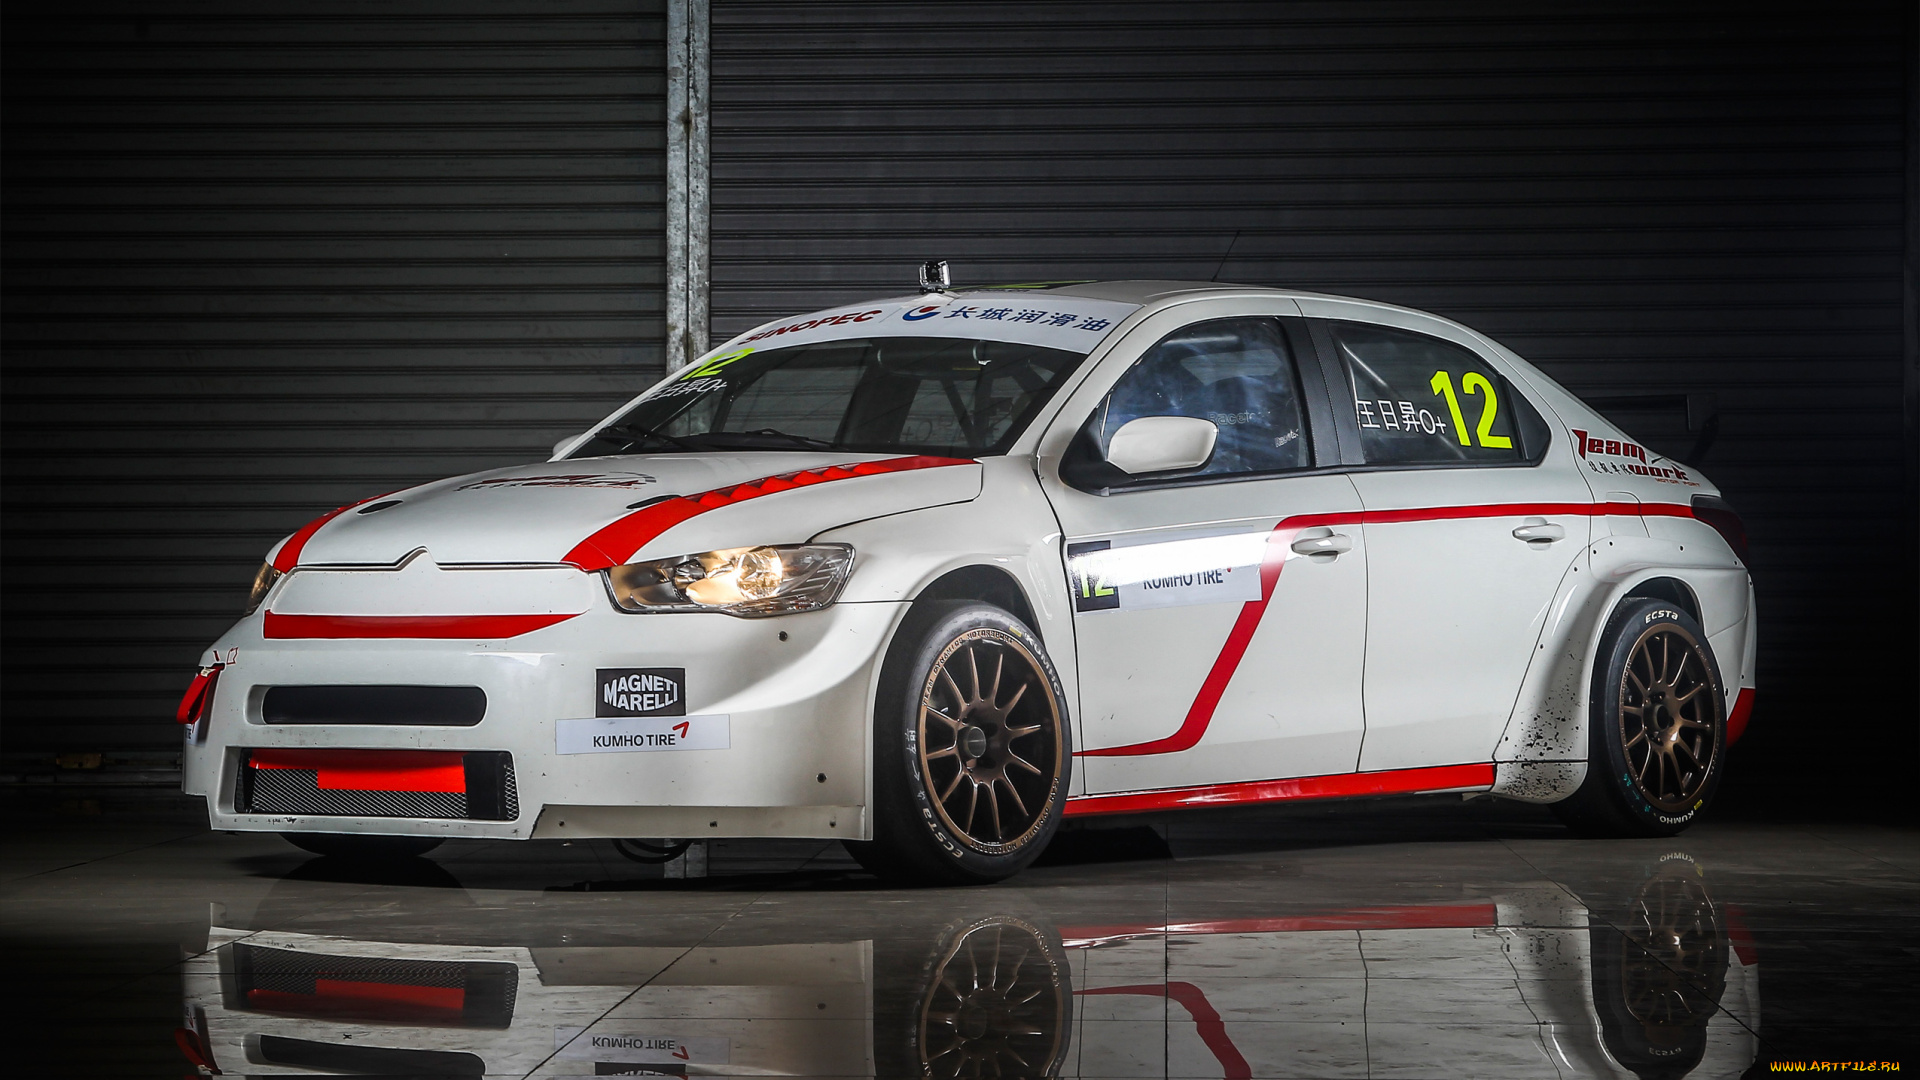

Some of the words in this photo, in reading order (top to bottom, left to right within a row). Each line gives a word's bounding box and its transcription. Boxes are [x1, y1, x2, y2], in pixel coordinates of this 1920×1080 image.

[737, 310, 882, 345] SINOPEC
[944, 306, 1110, 332] 长城润滑油
[1430, 370, 1513, 449] 12
[1571, 429, 1647, 465] Team
[1628, 464, 1689, 481] work
[604, 674, 678, 697] MAGNETI
[604, 692, 678, 711] MARELLI
[593, 735, 644, 748] KUMHO
[646, 734, 676, 746] TIRE
[1659, 810, 1695, 824] KUMHO
